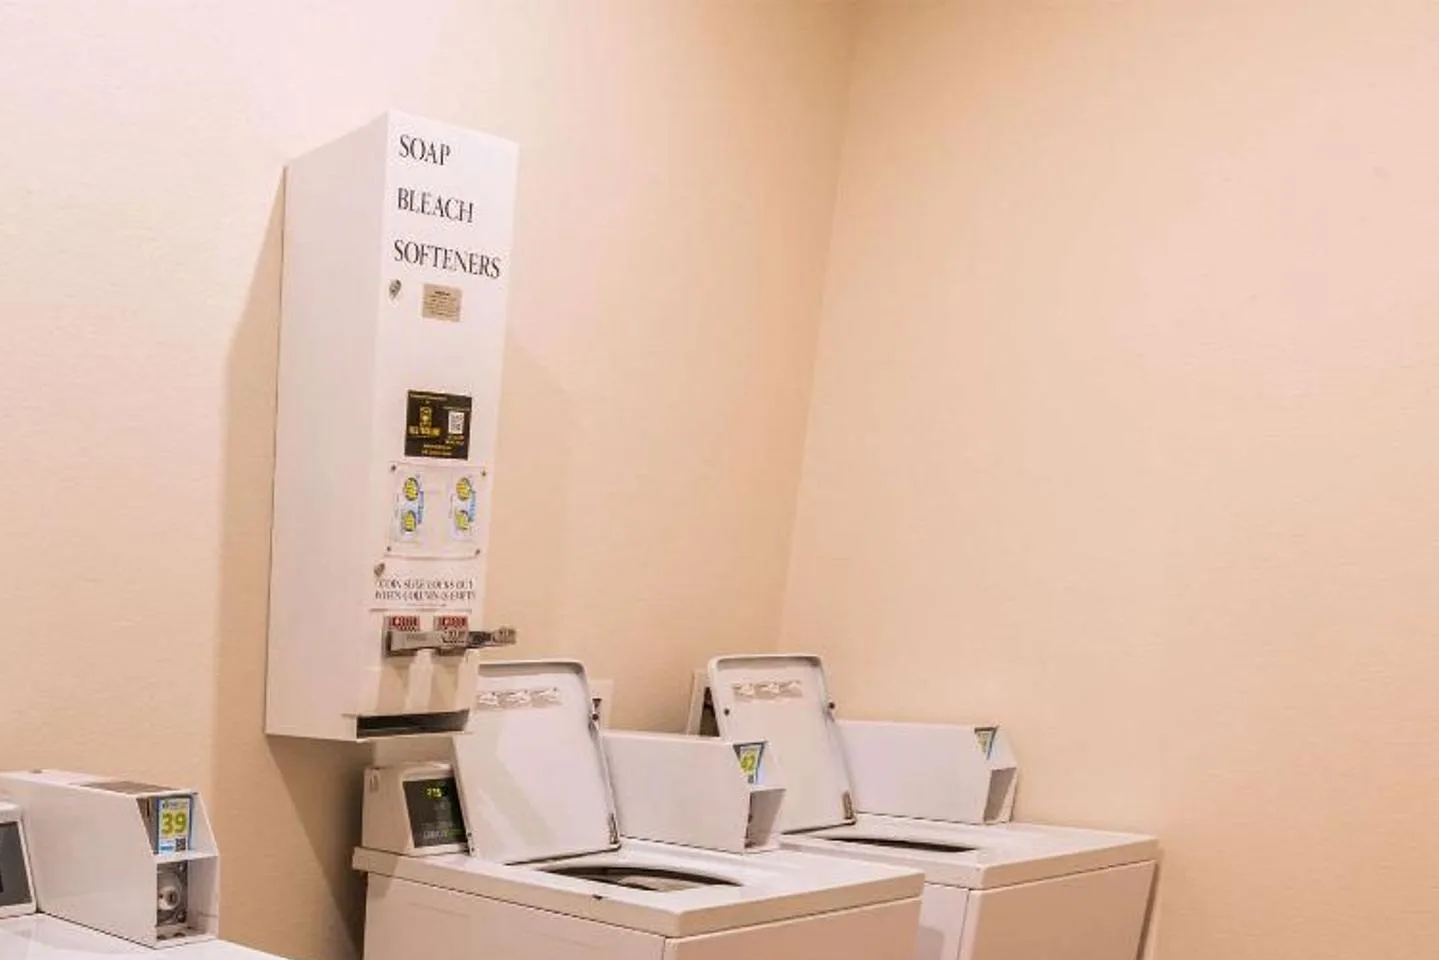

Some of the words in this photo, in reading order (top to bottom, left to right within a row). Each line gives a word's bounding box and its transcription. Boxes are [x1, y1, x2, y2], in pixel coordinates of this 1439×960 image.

[398, 134, 451, 166] SOAP
[397, 187, 474, 223] BLEACH
[393, 239, 502, 278] SOFTENERS
[161, 811, 187, 836] 39
